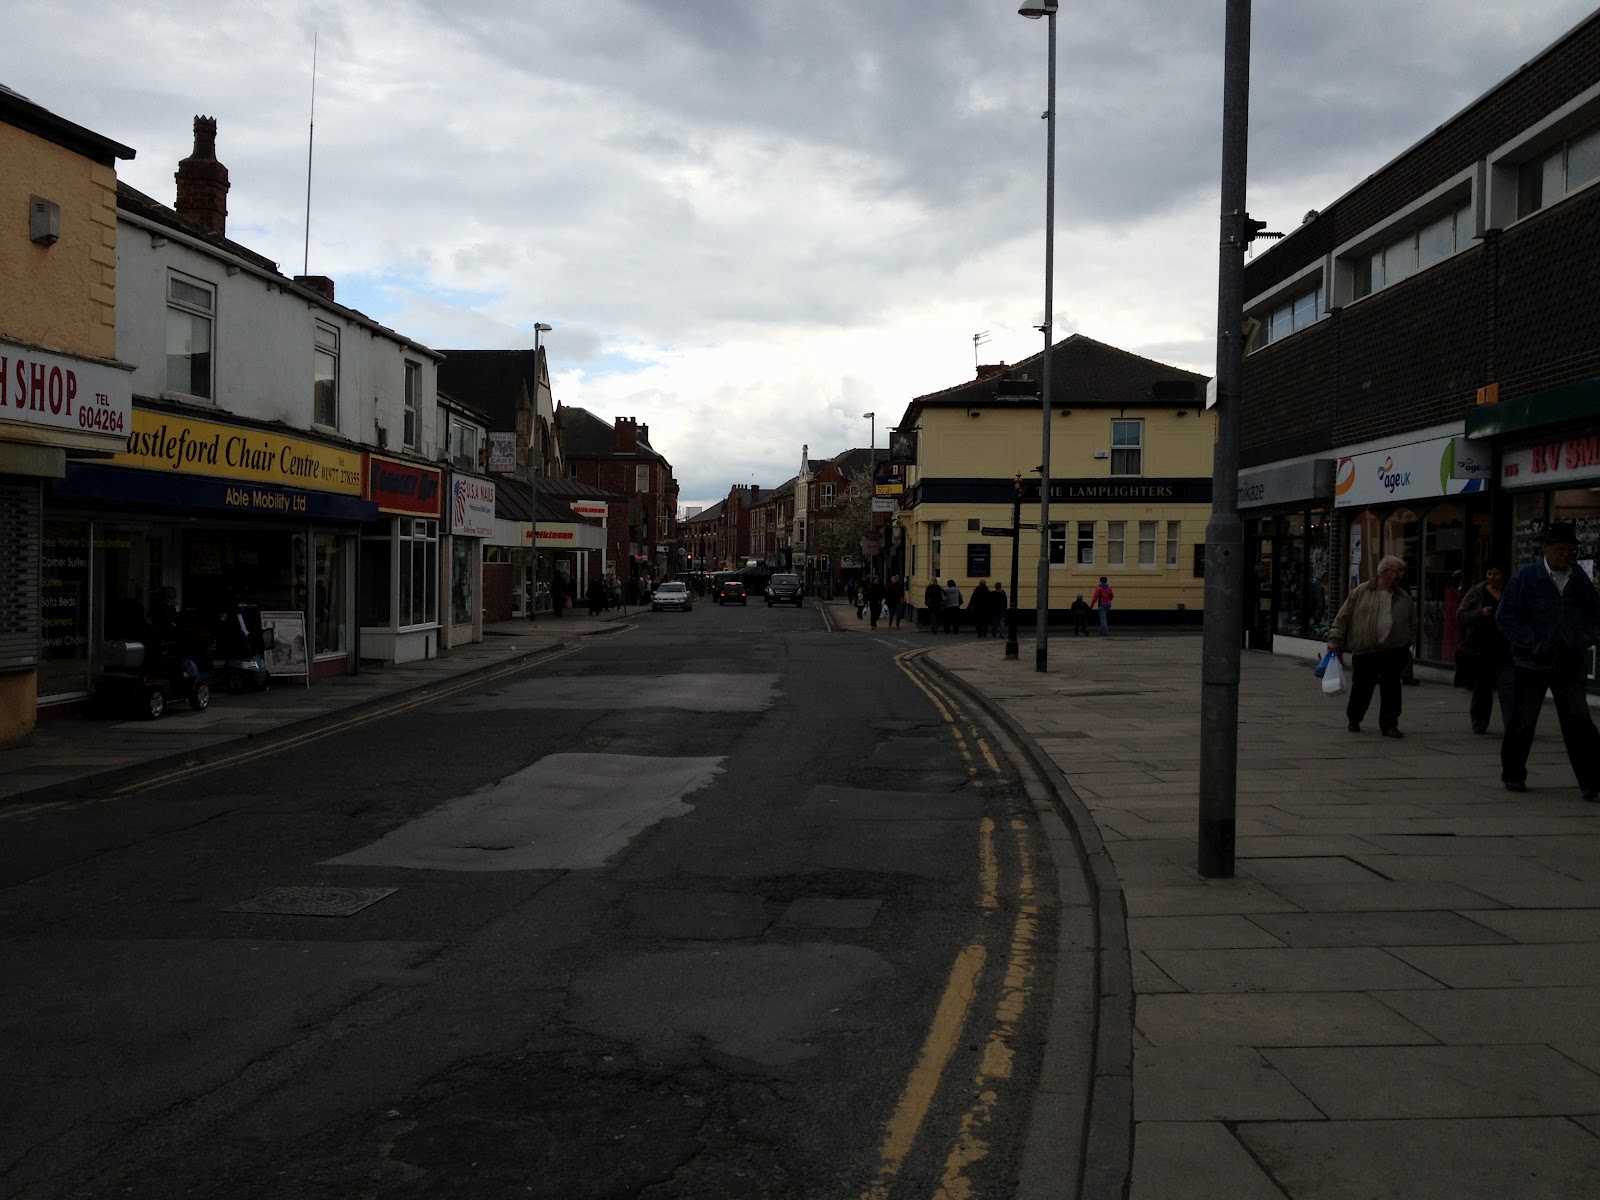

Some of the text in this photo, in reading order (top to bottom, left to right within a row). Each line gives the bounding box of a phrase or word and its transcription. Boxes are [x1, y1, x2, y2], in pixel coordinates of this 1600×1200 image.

[15, 359, 77, 416] SHOP
[95, 393, 110, 406] TEL
[79, 405, 123, 432] 604264
[127, 425, 320, 478] astleford Chair Centre
[1531, 442, 1560, 473] RV
[321, 465, 338, 482] 01977
[225, 488, 306, 513] Able Mobility Ltd
[480, 485, 493, 503] NAILS
[1069, 486, 1173, 497] LAMPLIGHTERS
[1238, 480, 1264, 502] mikaze
[42, 556, 88, 567] Corner Suites
[41, 596, 76, 607] Sofa Beds
